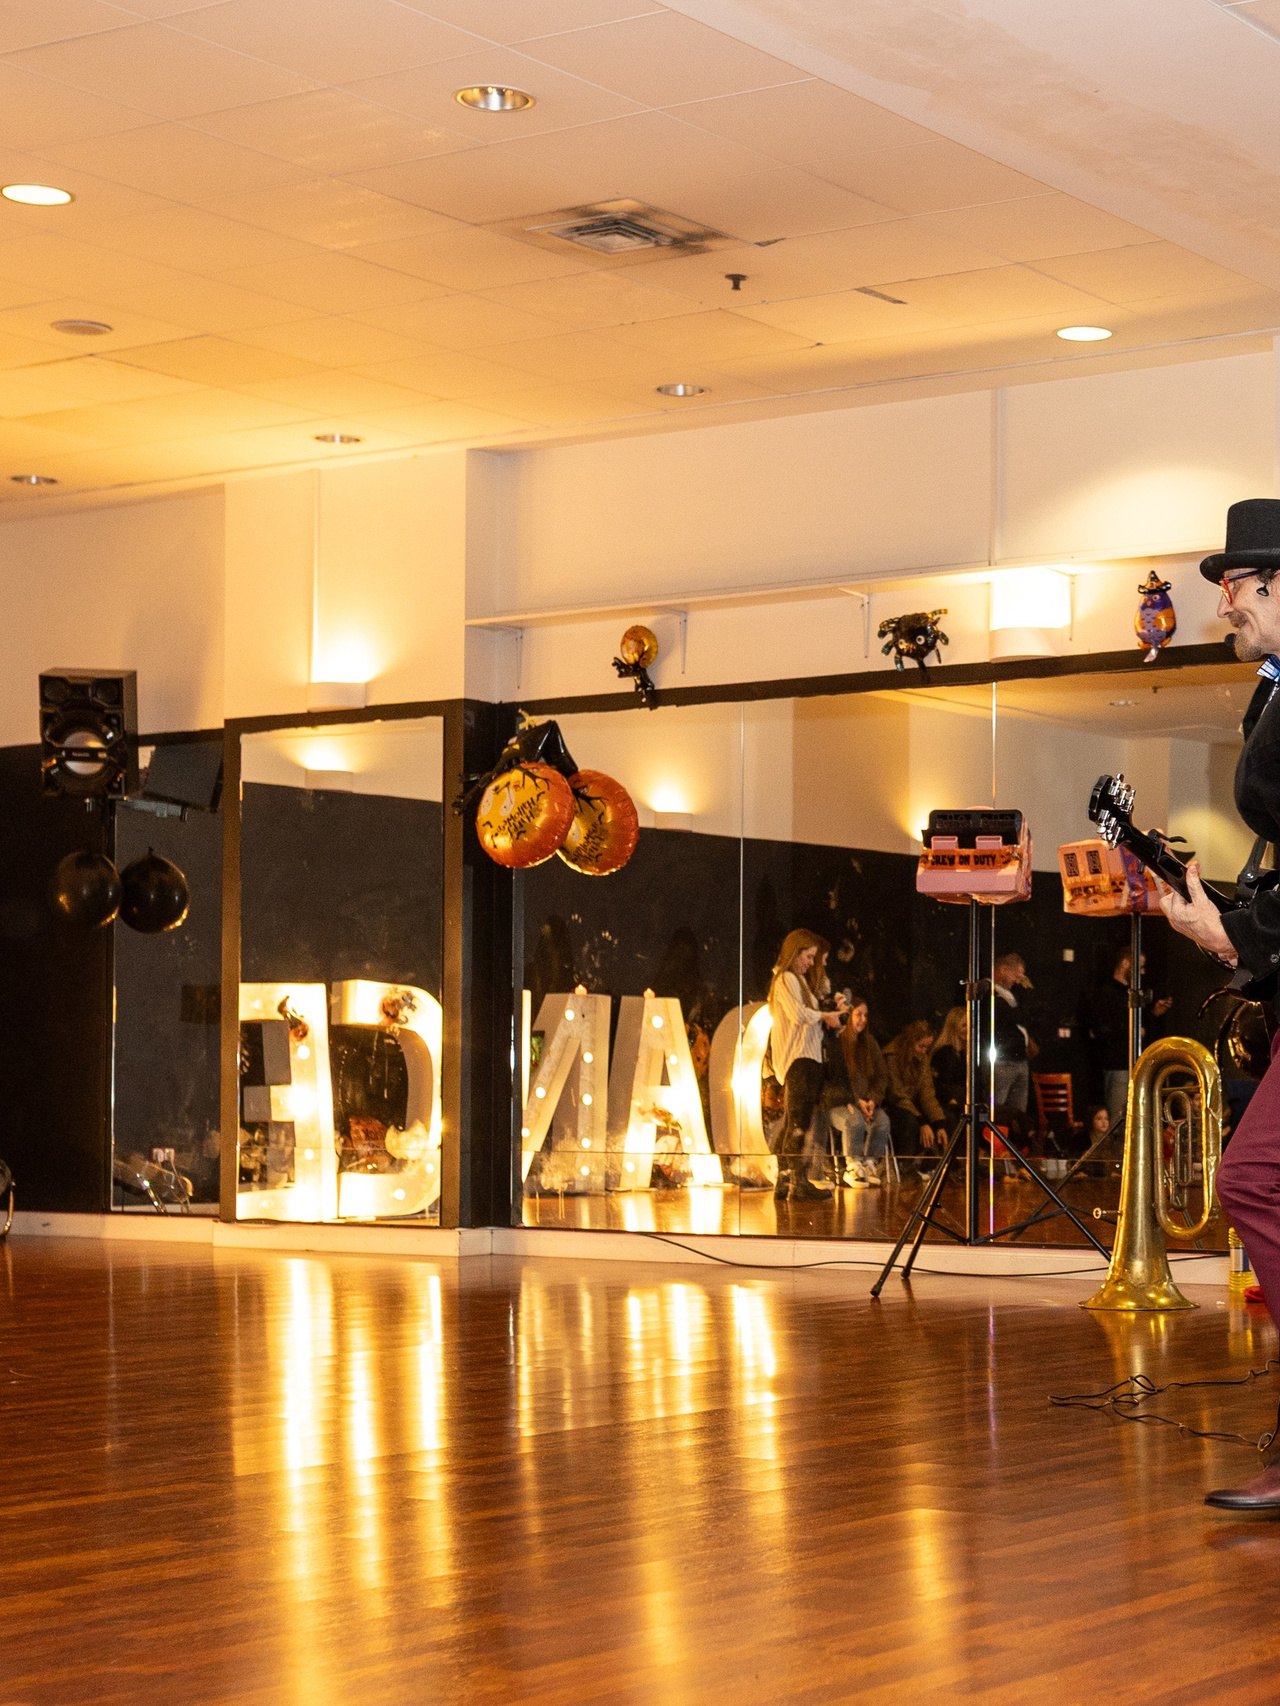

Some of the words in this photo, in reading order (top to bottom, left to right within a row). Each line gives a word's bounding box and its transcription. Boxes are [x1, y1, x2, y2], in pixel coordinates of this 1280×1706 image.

[931, 854, 956, 867] CREW
[958, 854, 971, 866] ON
[973, 854, 997, 867] DUTY
